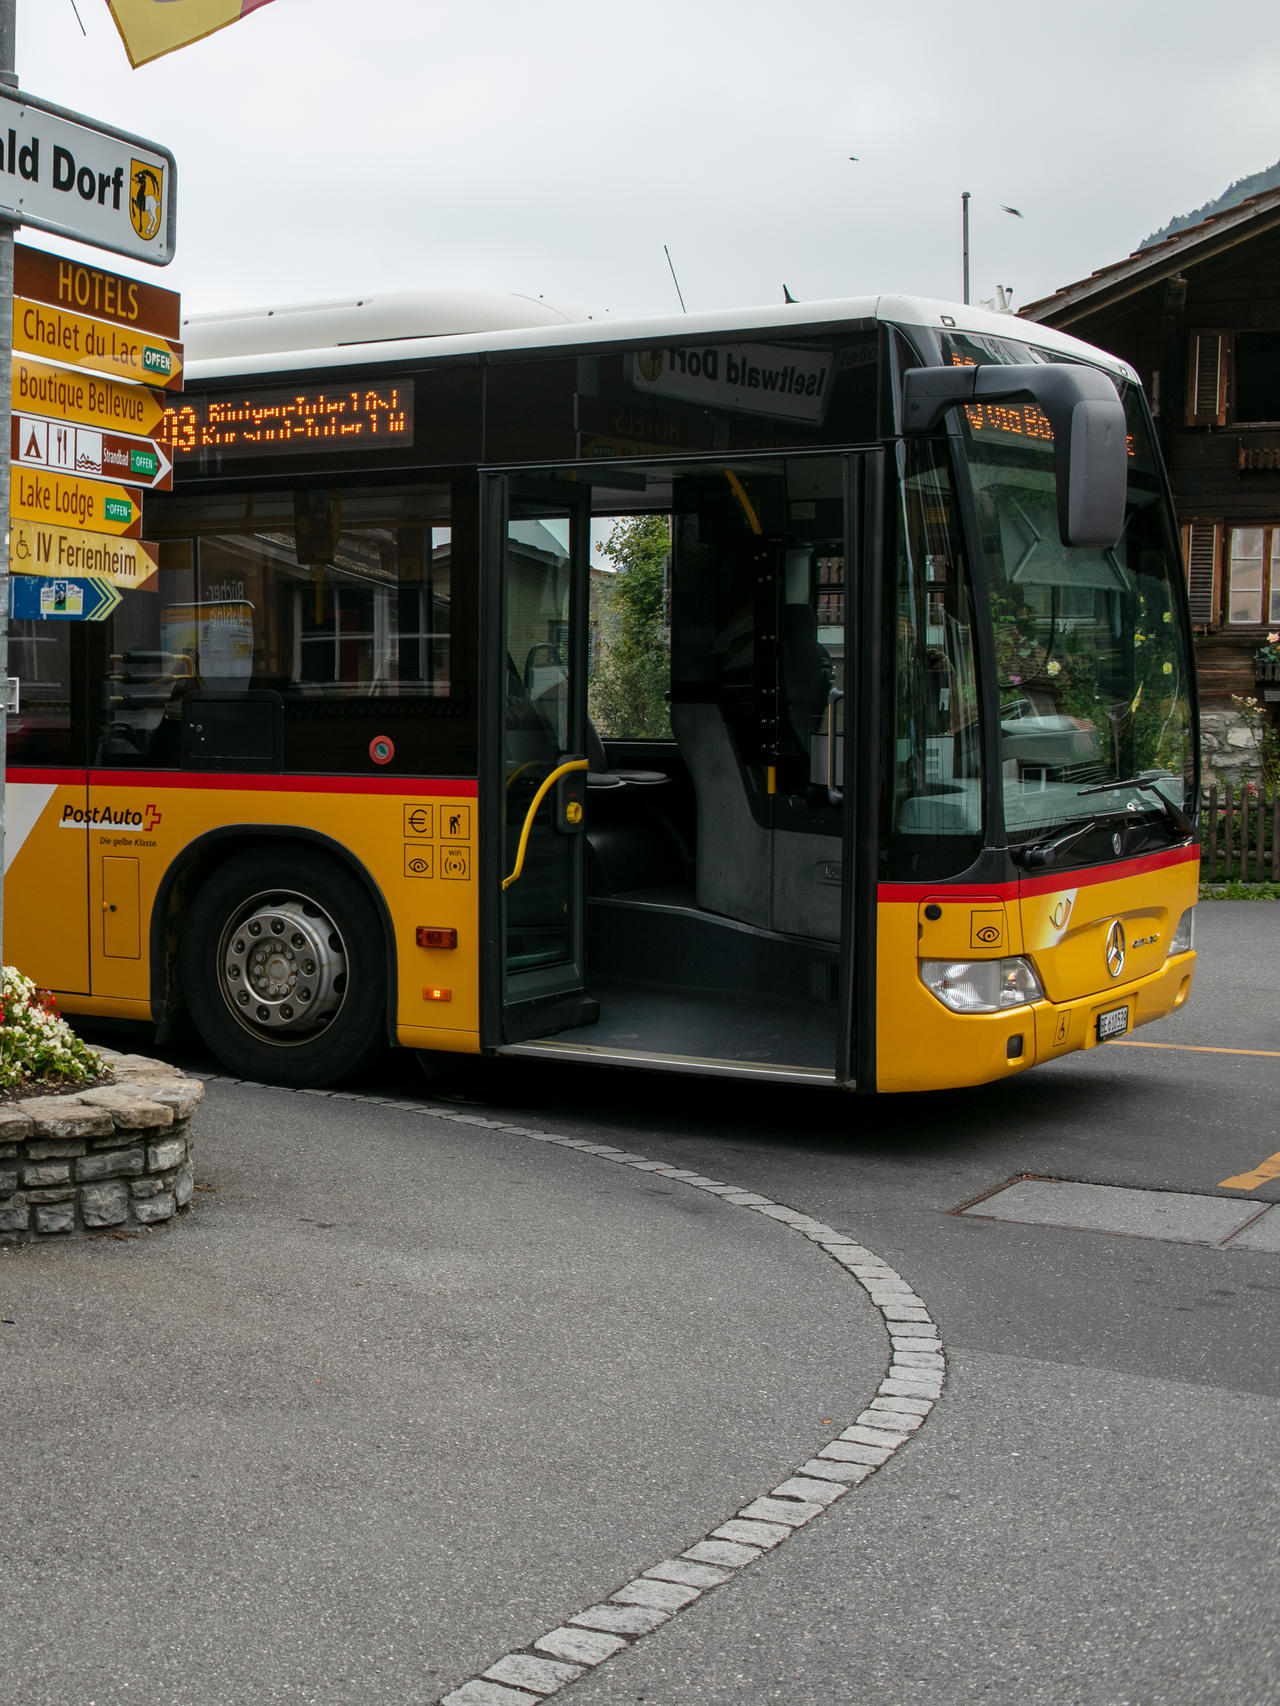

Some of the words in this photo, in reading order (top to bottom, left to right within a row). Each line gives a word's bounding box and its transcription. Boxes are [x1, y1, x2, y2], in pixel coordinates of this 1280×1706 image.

[52, 143, 125, 211] Dorf
[58, 260, 139, 321] HOTELS
[23, 308, 80, 352] Chalet
[85, 323, 105, 358] du
[112, 329, 138, 367] Lac
[144, 351, 171, 370] OFFEN
[19, 367, 84, 414] Boutique
[89, 382, 144, 422] Bellevue
[103, 447, 129, 466] Strandbad
[135, 456, 153, 470] OFFEN
[20, 475, 51, 510] Lake
[55, 482, 94, 524] Lodge
[109, 504, 128, 517] OFFEN
[36, 532, 53, 563] IV
[58, 536, 136, 576] Ferienheim
[62, 804, 143, 826] PostAuto
[99, 836, 112, 845] Die
[113, 836, 133, 847] gelbe
